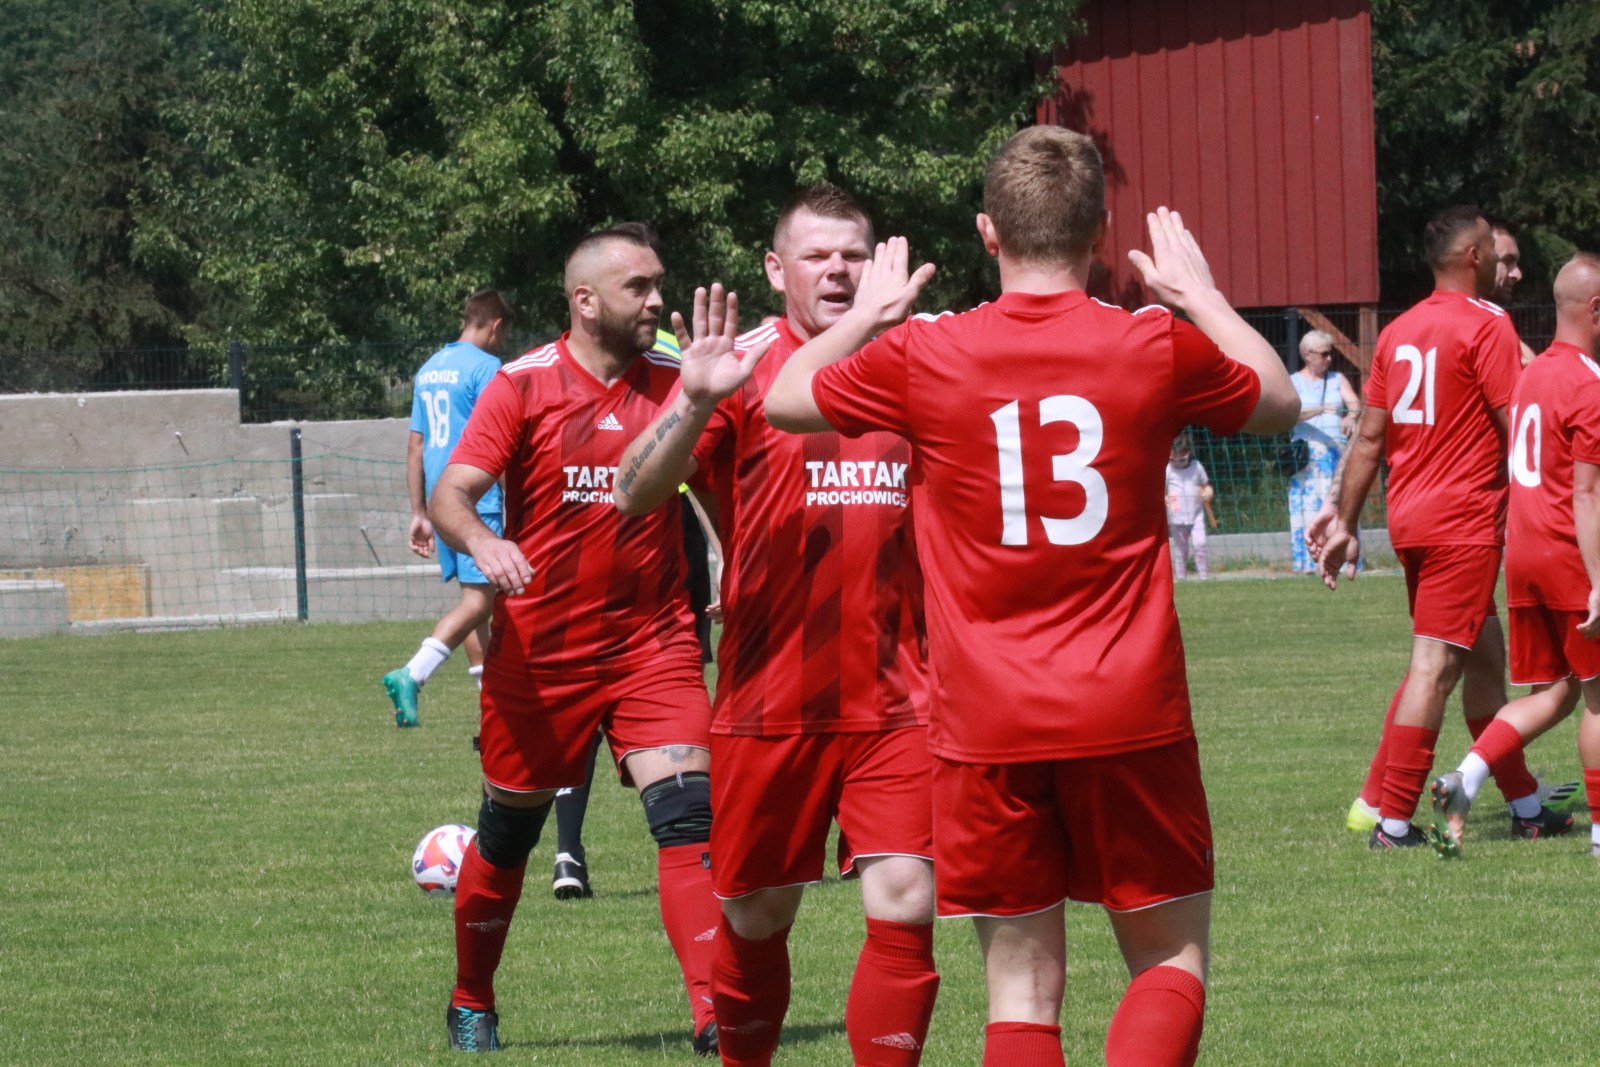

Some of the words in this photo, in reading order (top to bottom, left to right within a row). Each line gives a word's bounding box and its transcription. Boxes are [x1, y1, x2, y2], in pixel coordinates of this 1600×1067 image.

[1392, 344, 1437, 425] 21
[420, 389, 450, 448] 18
[598, 423, 623, 431] adidas
[805, 461, 908, 489] TARTAK
[989, 394, 1109, 545] 13
[806, 490, 907, 507] PROCHOWICE
